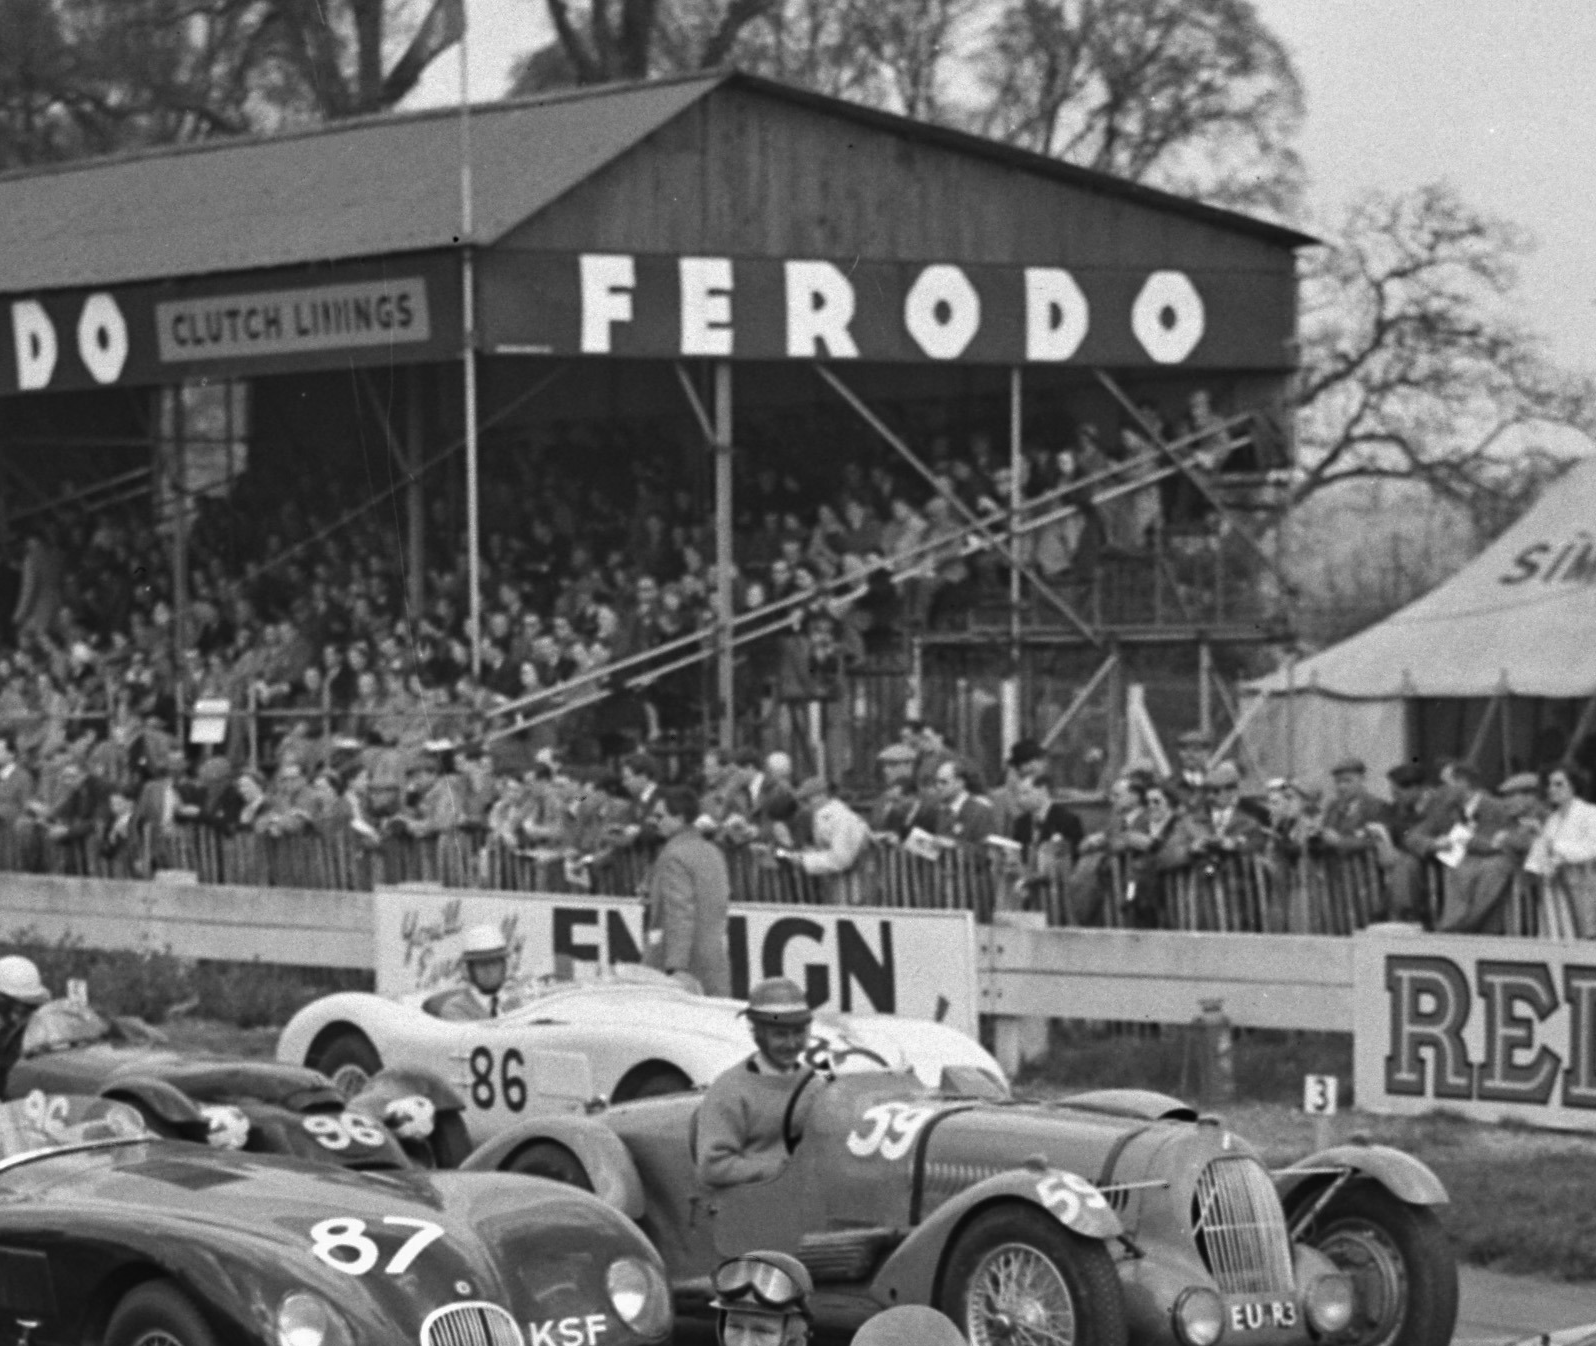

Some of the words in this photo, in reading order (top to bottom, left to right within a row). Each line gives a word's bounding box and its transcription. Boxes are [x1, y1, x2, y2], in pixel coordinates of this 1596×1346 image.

[171, 306, 283, 347] CLUTCH
[292, 293, 414, 338] LININGS
[577, 252, 1206, 365] FERODO
[469, 1045, 528, 1113] 86
[304, 1114, 385, 1151] 96
[309, 1216, 445, 1276] 87
